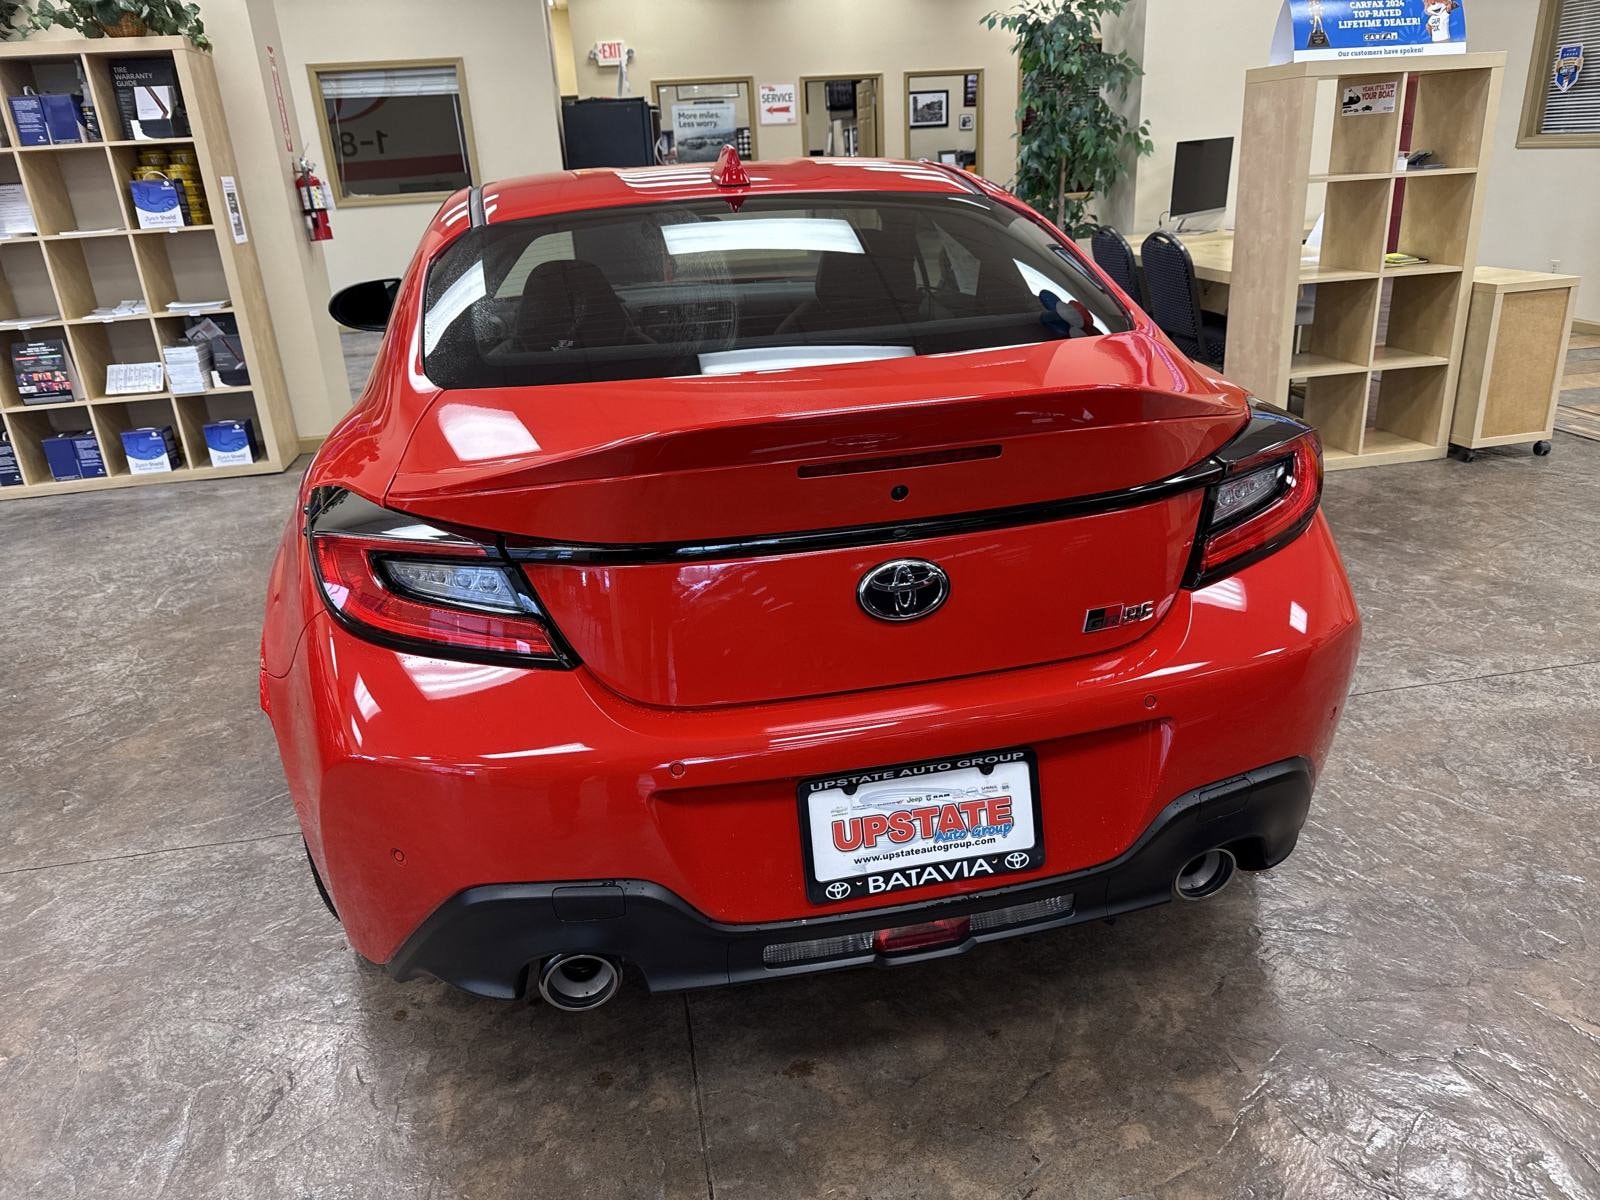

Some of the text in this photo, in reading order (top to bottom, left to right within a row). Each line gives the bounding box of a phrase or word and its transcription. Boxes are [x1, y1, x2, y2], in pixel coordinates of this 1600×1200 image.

[1349, 0, 1405, 9] CARFAX 2024
[1352, 9, 1402, 18] TOP-RATED
[1338, 17, 1421, 29] LIFETIME DEALER!
[601, 42, 622, 59] EXIT
[1399, 47, 1424, 55] spoken!
[114, 72, 153, 80] WARRANTY
[761, 92, 793, 103] SERVICE
[1362, 91, 1377, 100] YOUR
[698, 111, 721, 119] miles.
[678, 120, 719, 129] Less worry.
[1123, 600, 1155, 625] 86
[810, 752, 1025, 792] UPSTATE AUTO GROUP
[906, 796, 923, 804] Jeep
[831, 795, 1014, 853] UPSTATE
[934, 823, 1013, 844] Auto Group
[853, 836, 996, 864] www.upstateautogroup.com
[867, 858, 994, 894] BATAVIA
